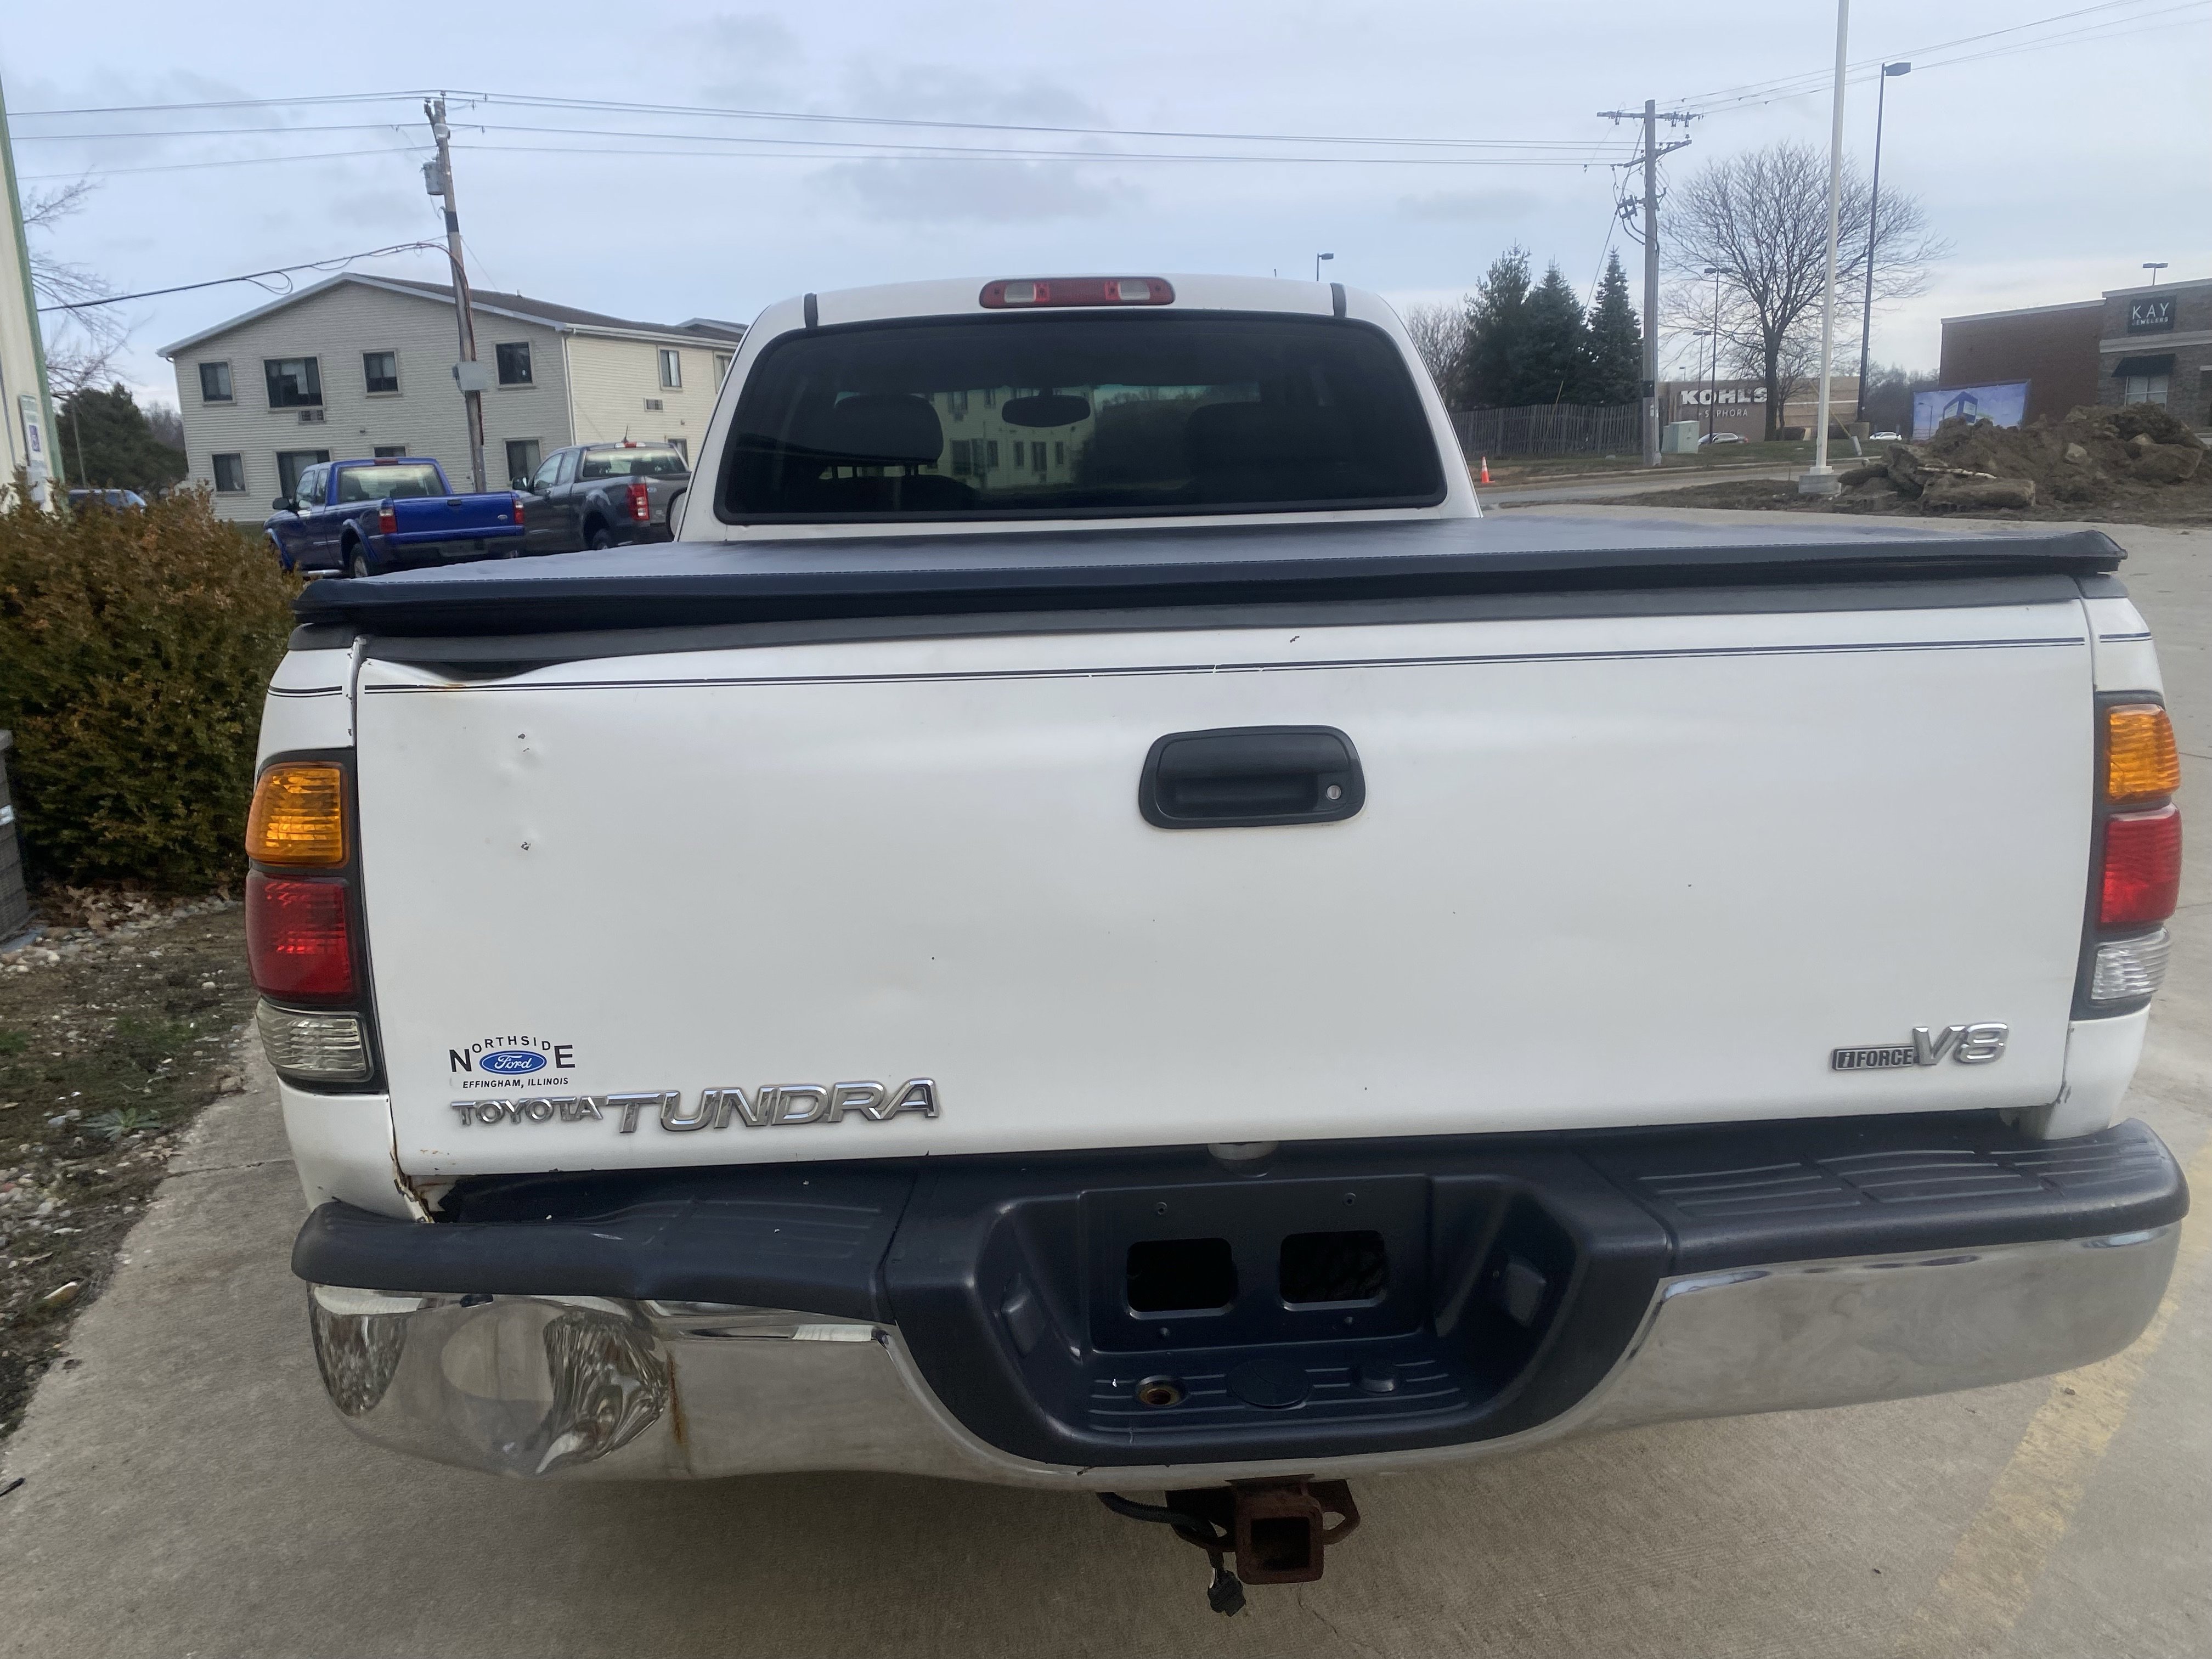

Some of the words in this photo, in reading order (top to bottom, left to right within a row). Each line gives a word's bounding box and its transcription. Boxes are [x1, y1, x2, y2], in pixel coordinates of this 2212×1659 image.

[2132, 302, 2169, 319] KAY
[1705, 409, 1748, 418] SPHORA
[1912, 1023, 2009, 1066] V8
[449, 1036, 575, 1073] NORTHSIDE
[494, 1054, 533, 1069] Ford
[462, 1079, 524, 1088] EFFINGHAM,
[528, 1077, 568, 1086] ILLINOIS
[451, 1096, 603, 1126] TOYOTA
[606, 1078, 939, 1133] TUNDRA
